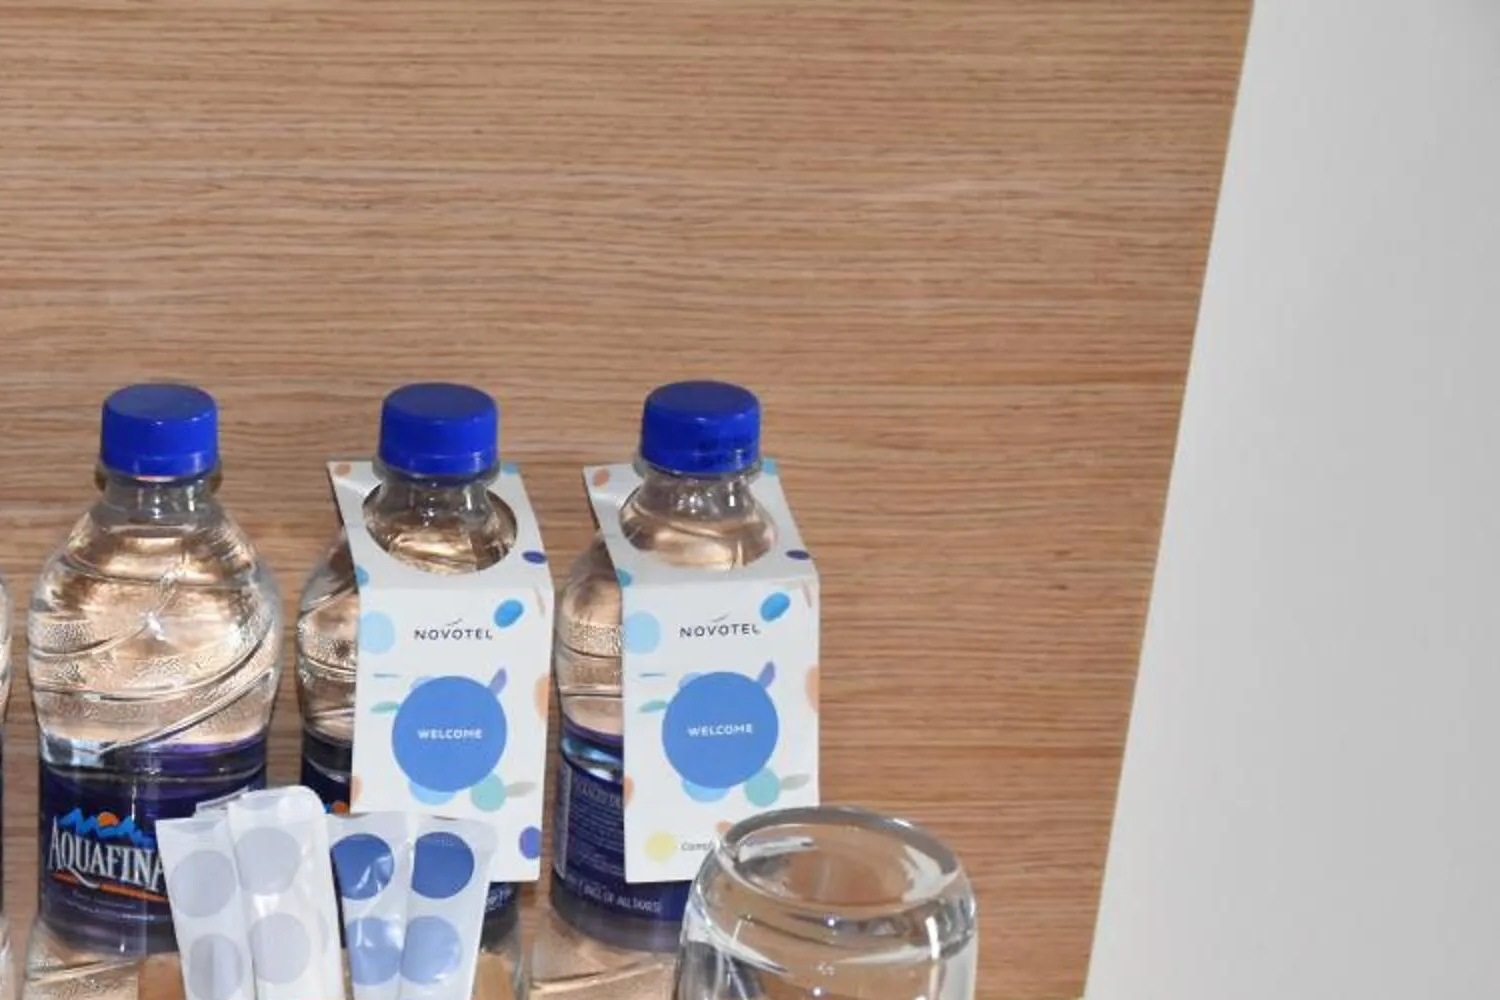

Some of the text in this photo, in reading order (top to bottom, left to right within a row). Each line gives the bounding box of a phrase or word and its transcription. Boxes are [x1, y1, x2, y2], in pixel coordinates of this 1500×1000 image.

[413, 627, 493, 641] NOVOTEL
[679, 622, 762, 638] NOVOTEL
[417, 728, 483, 740] WELCOME
[687, 723, 754, 737] WELCOME
